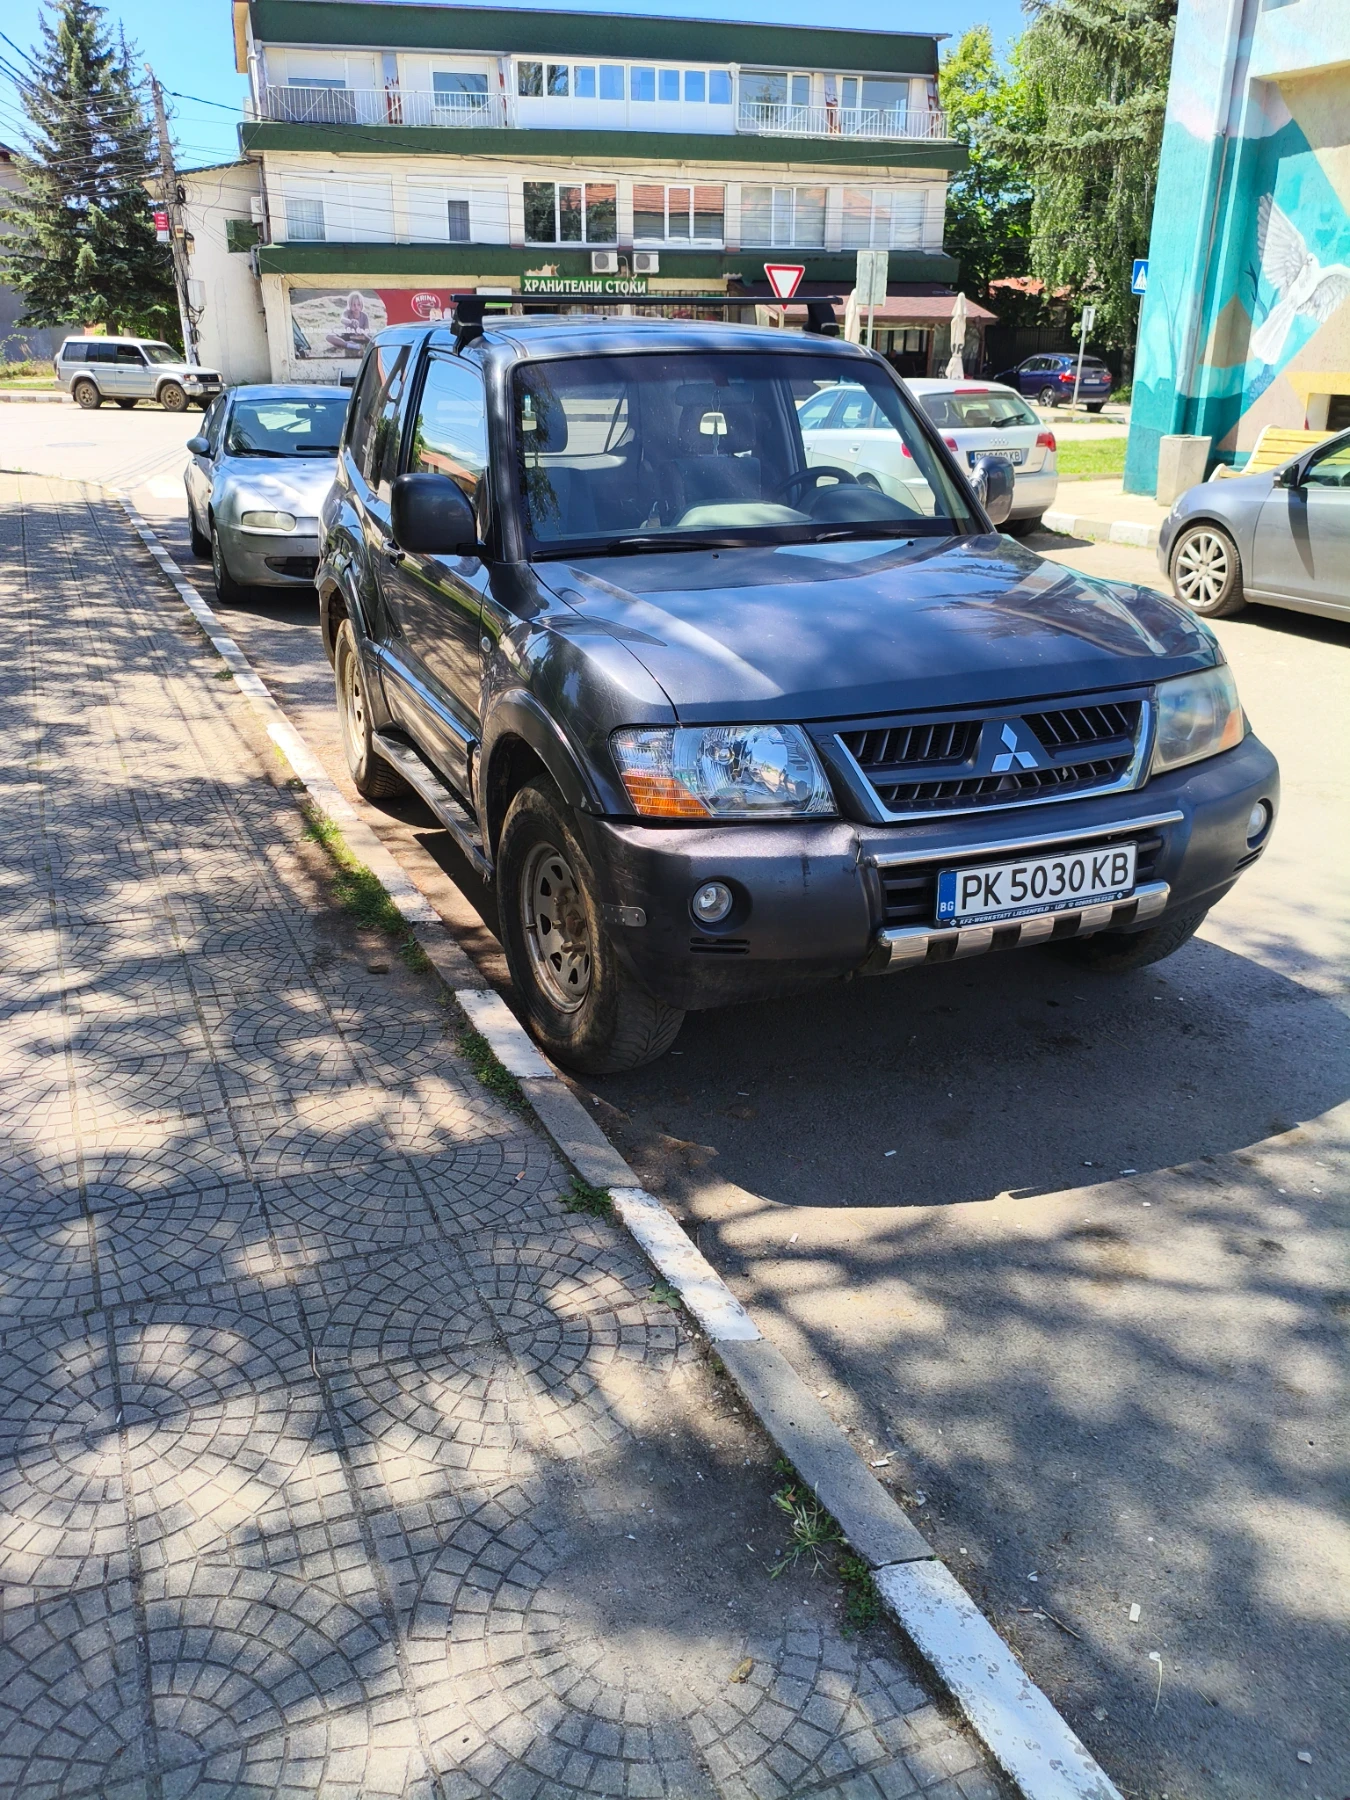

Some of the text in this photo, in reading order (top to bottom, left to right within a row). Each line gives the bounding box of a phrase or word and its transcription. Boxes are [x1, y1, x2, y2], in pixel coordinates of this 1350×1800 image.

[524, 279, 646, 294] ХРАНИТЕЛНИ СТОКИ
[415, 294, 437, 303] KRINA
[961, 852, 1129, 910] PK 5030 KB
[940, 900, 954, 913] BG
[959, 912, 1012, 925] KFZ-WERKSTATT
[1012, 906, 1050, 917] LIESENFELD
